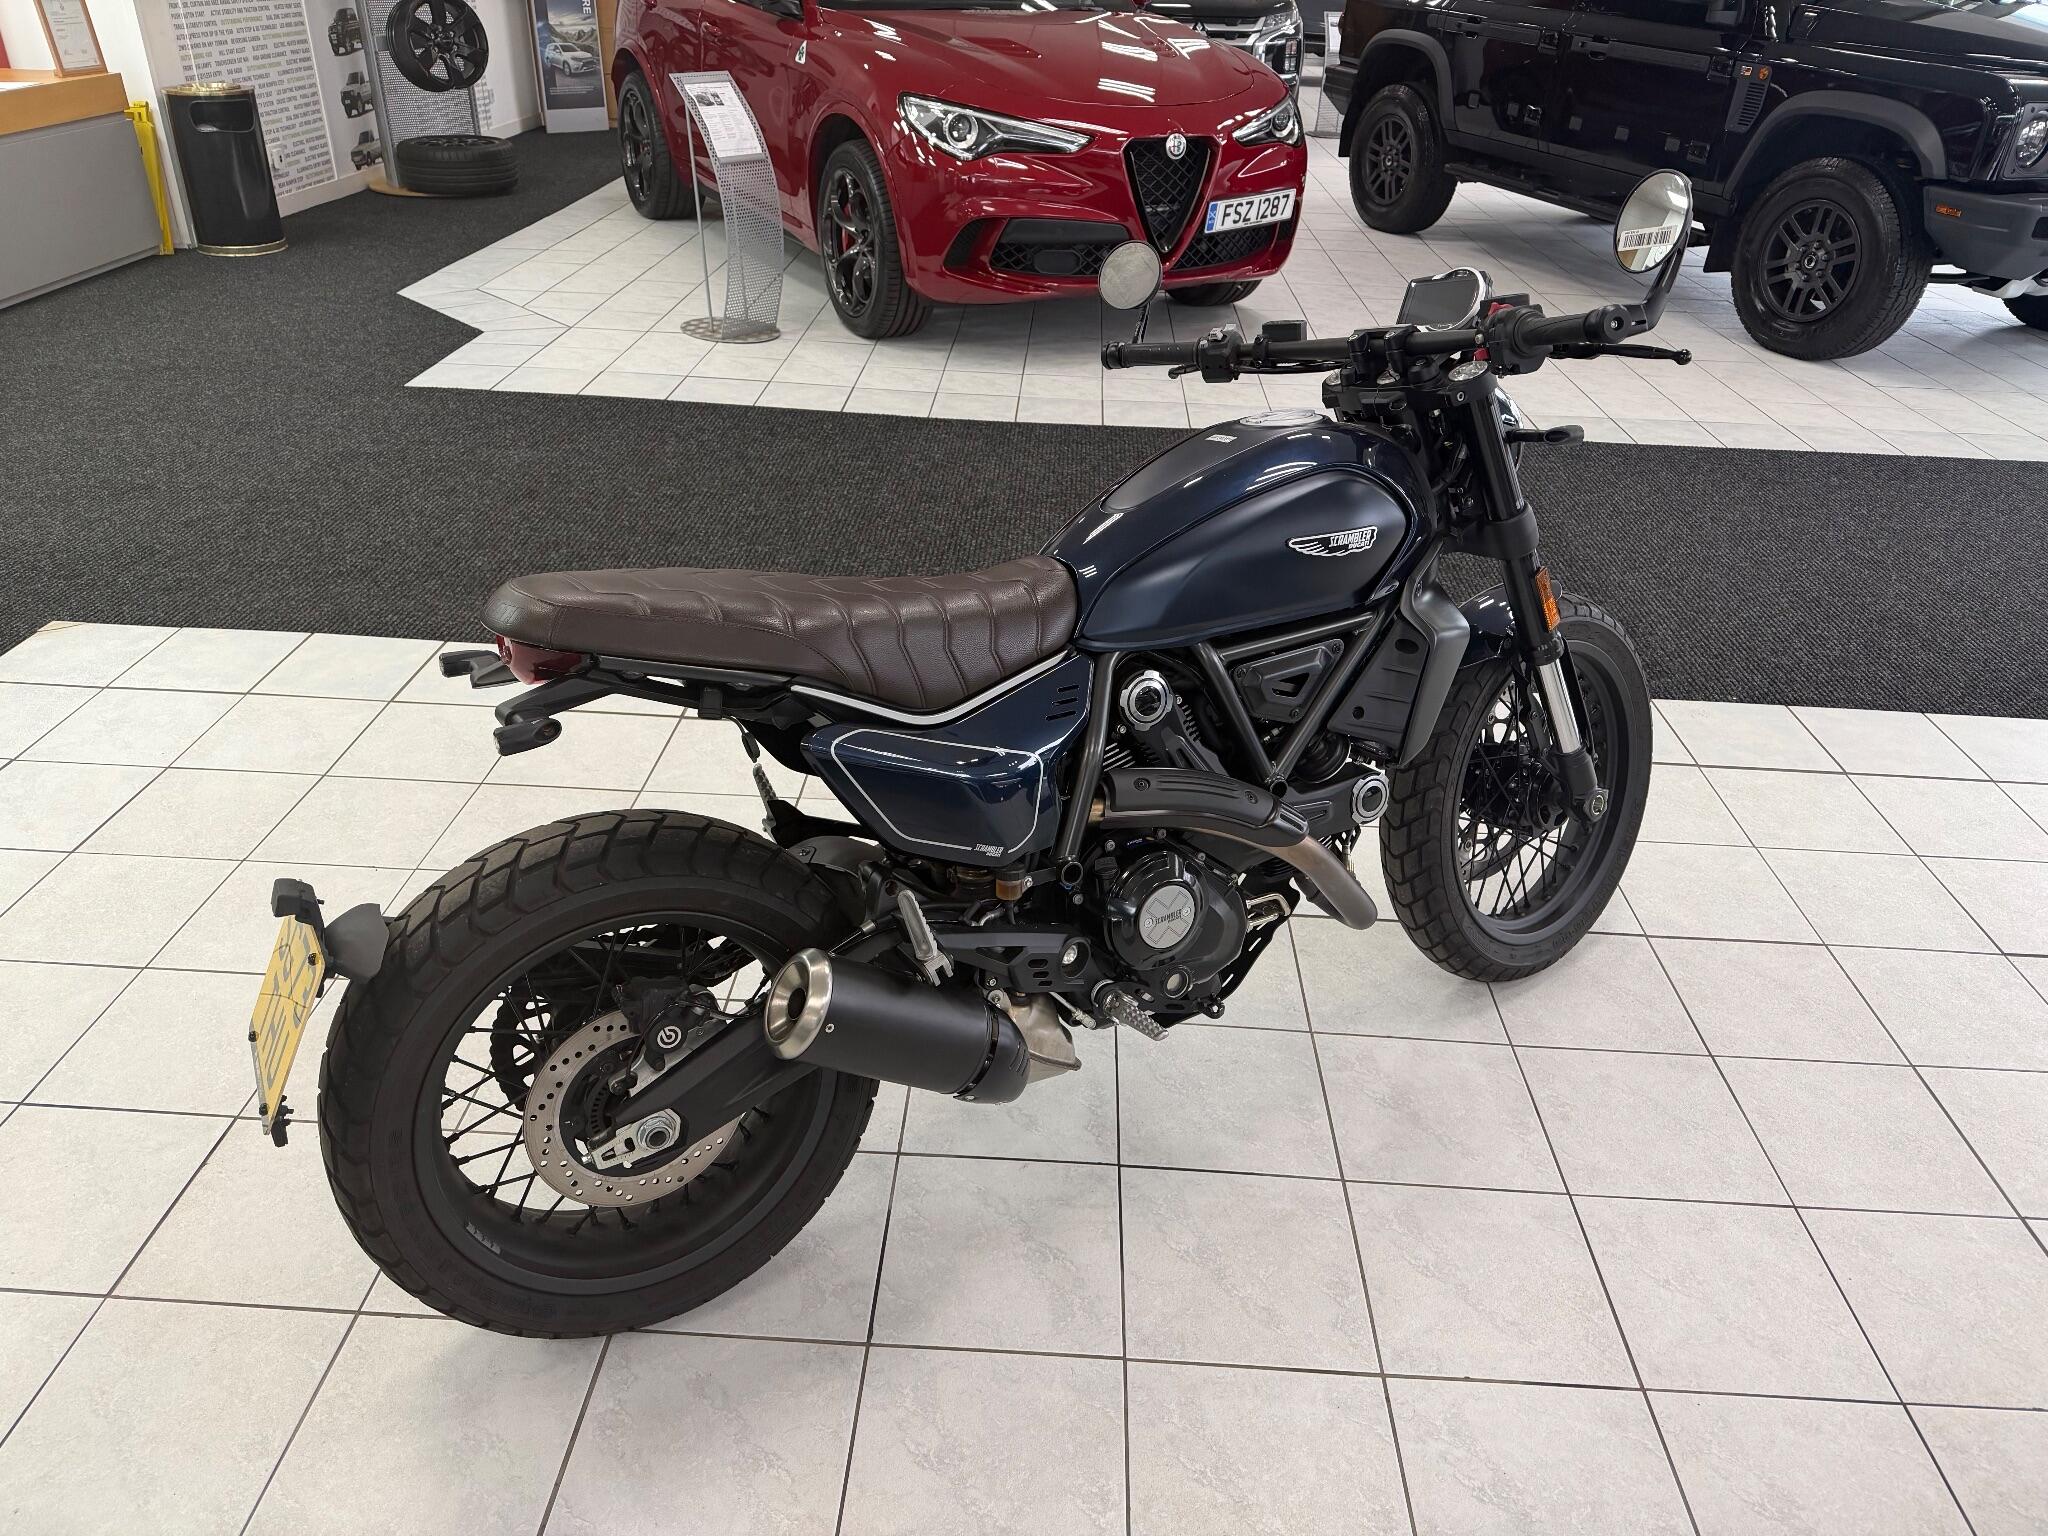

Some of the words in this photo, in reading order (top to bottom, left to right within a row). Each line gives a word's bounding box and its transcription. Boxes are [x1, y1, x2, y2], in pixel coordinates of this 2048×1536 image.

[1221, 200, 1254, 226] FSZ
[1256, 194, 1290, 220] 1287
[1329, 530, 1371, 547] SCRAMBLER
